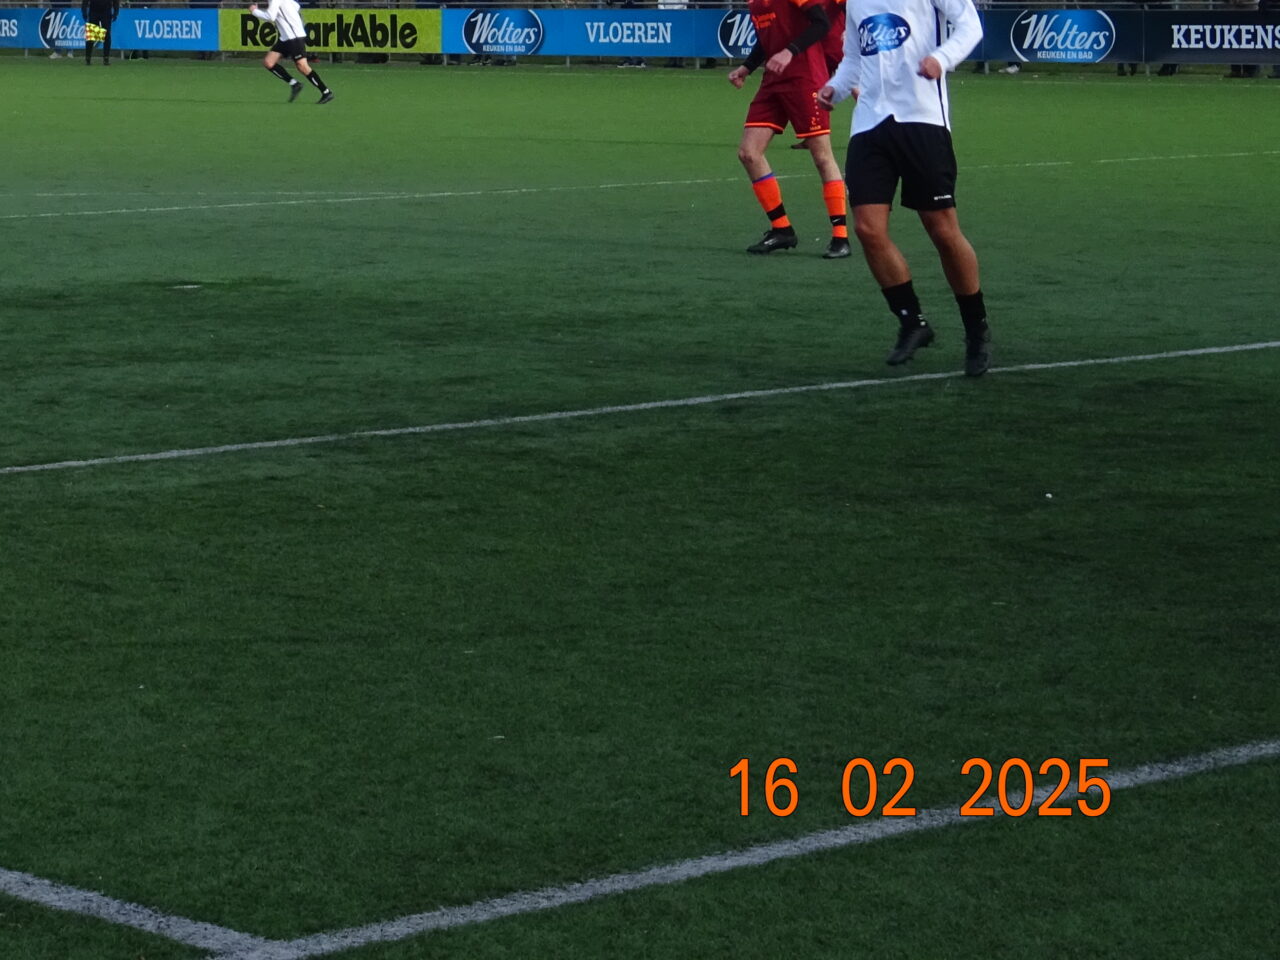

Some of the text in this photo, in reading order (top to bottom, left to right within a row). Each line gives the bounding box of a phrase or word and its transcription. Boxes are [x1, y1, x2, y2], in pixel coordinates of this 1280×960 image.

[134, 20, 202, 40] VLOEREN
[240, 14, 418, 49] RearkAble
[470, 12, 538, 44] Wolters
[585, 22, 672, 44] VLOEREN
[1020, 14, 1109, 50] Wolters
[1037, 50, 1093, 59] KEUKEN EN BAD
